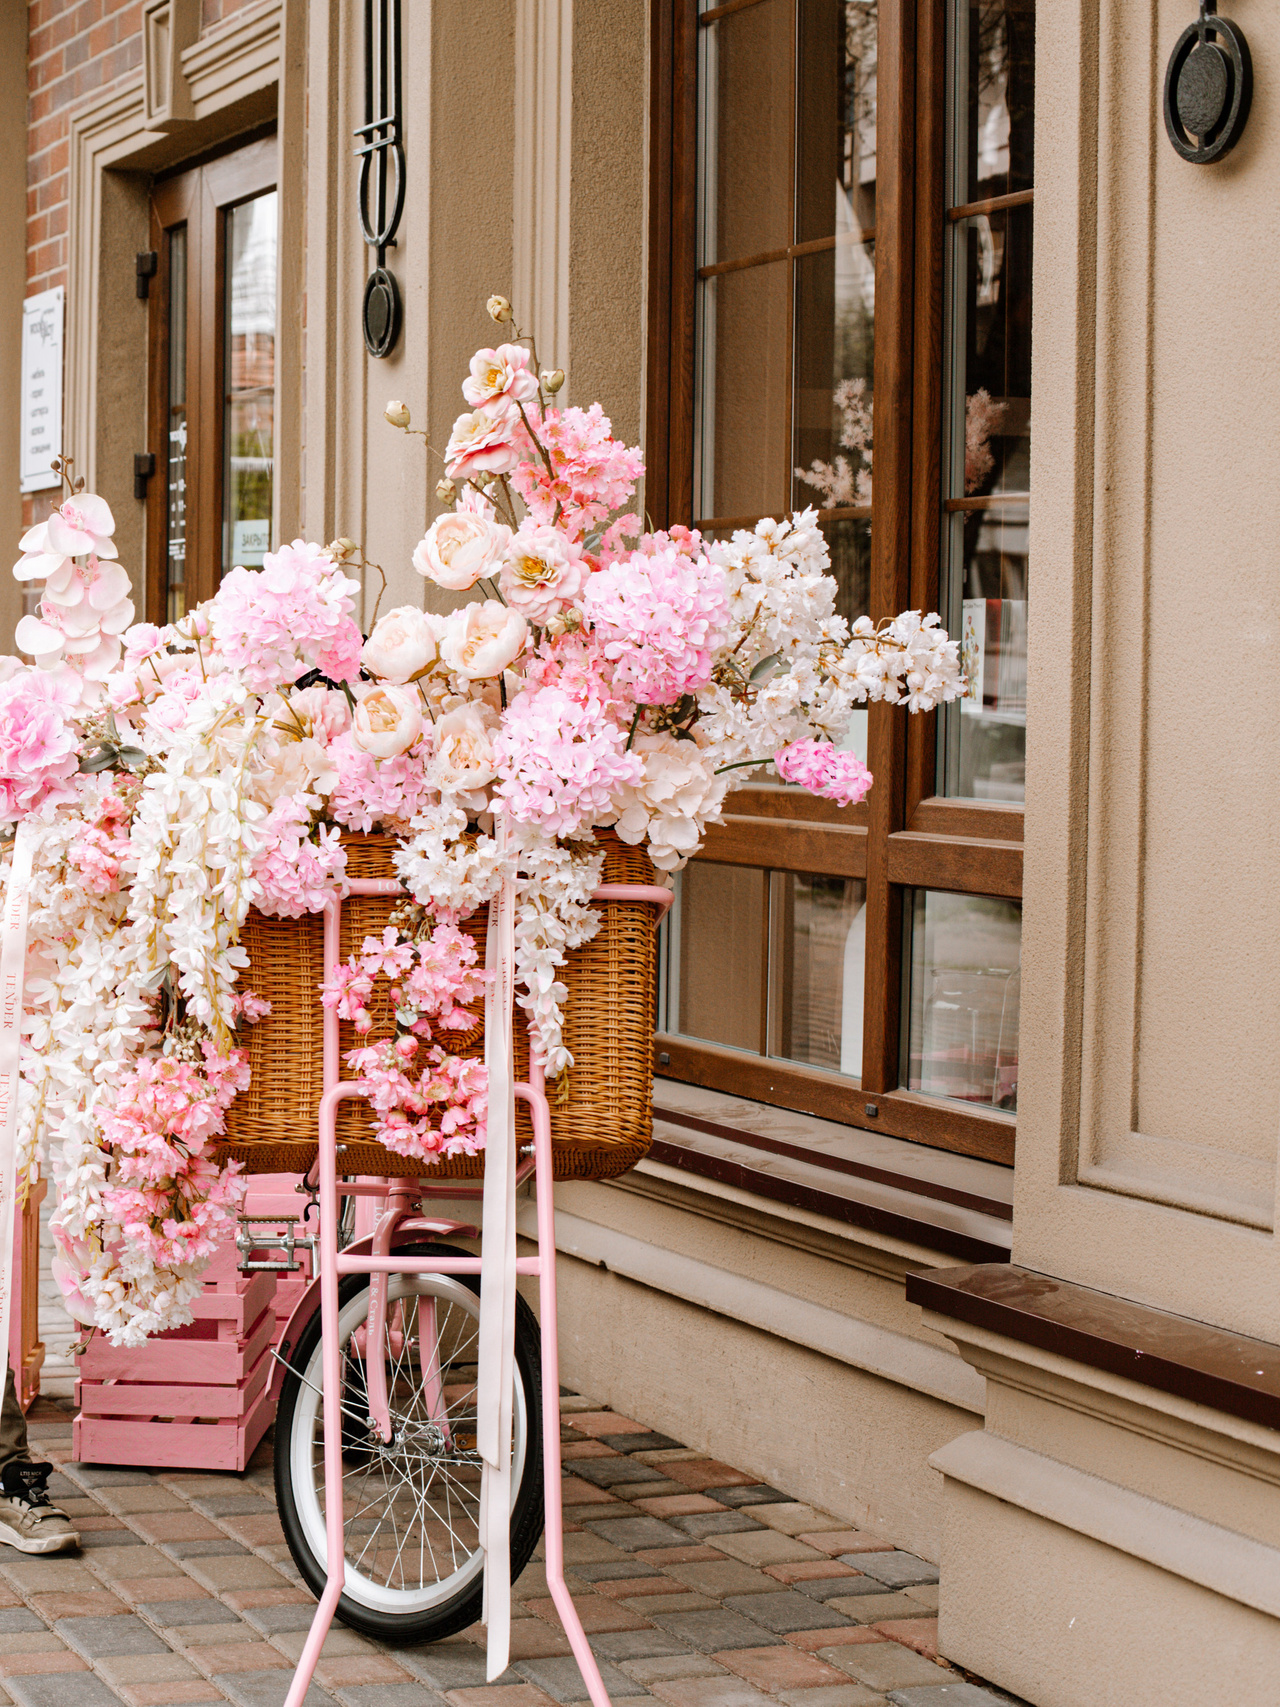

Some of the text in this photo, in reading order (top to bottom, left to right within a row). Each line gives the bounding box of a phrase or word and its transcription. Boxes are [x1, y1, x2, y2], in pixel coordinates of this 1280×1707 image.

[9, 884, 23, 931] ENDER
[3, 972, 17, 1030] TENDER
[370, 1287, 379, 1296] &
[368, 1299, 379, 1336] Сталь
